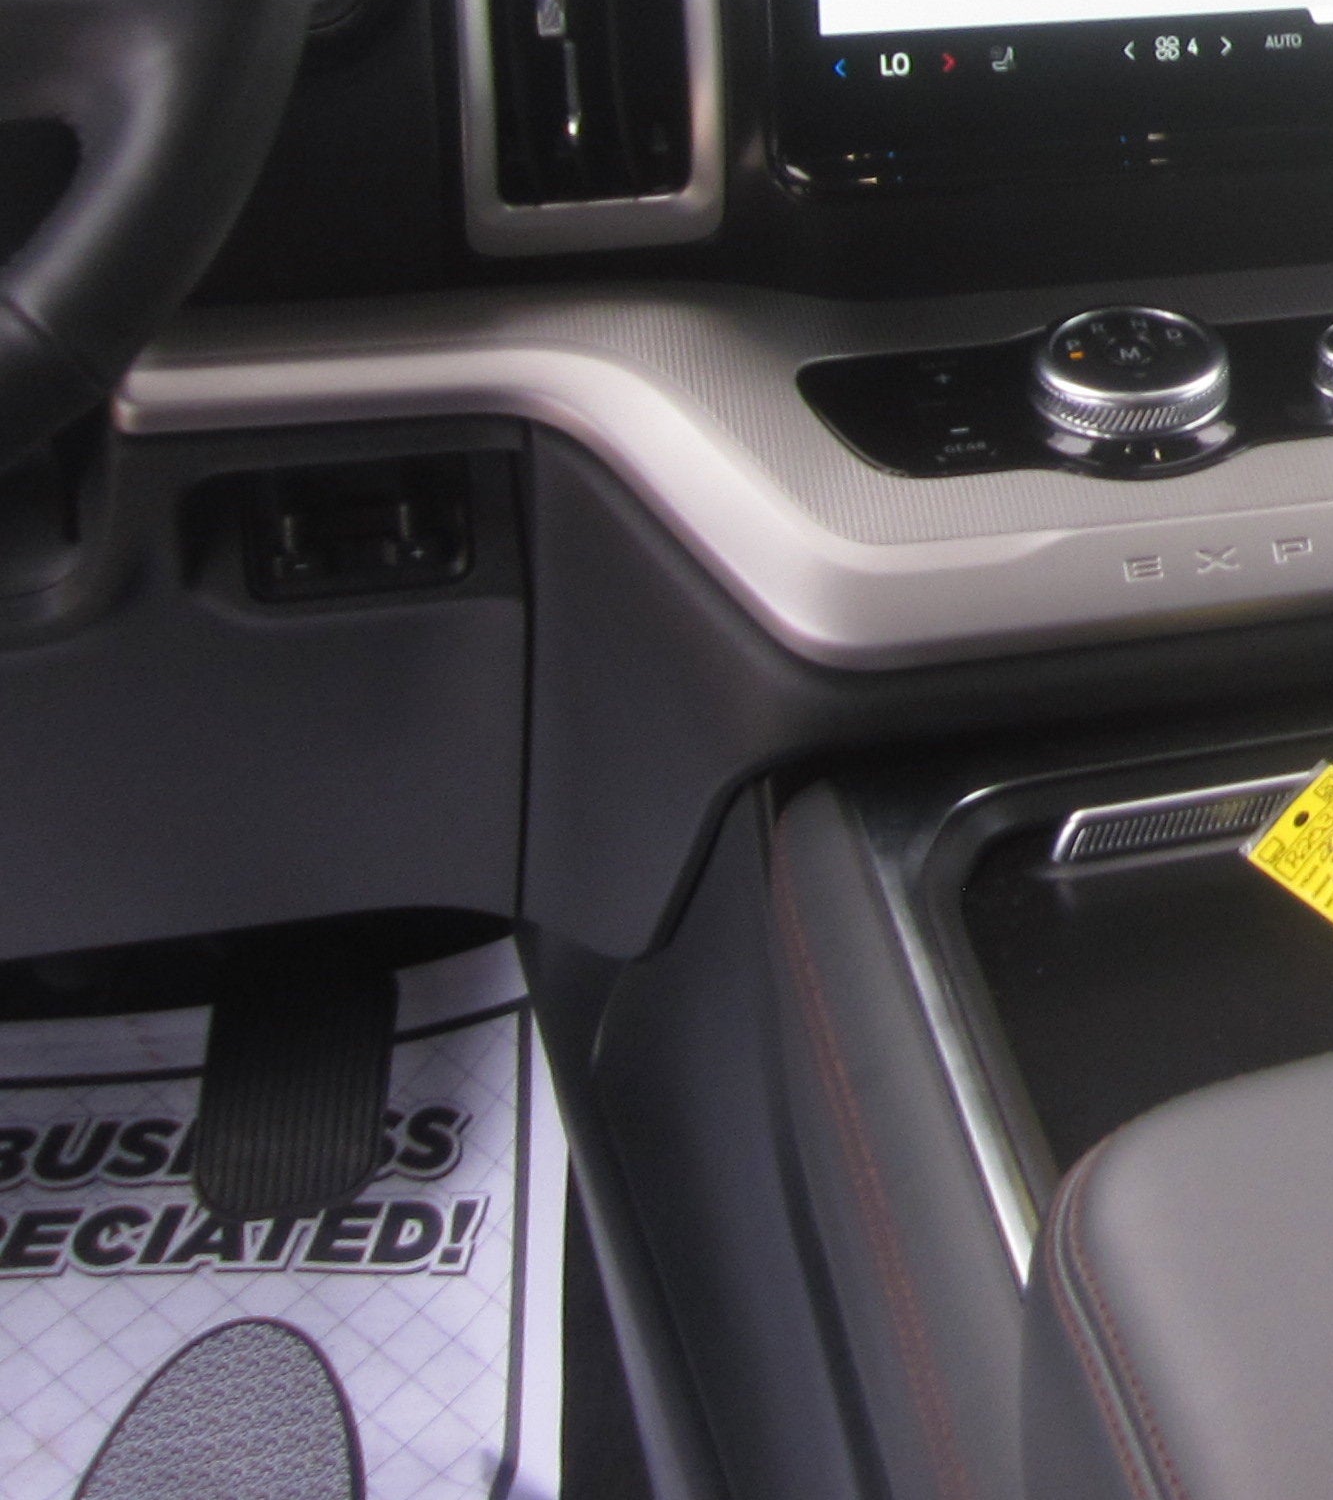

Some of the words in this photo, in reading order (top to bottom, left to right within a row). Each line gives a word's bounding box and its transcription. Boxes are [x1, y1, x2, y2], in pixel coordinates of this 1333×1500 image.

[1187, 38, 1199, 56] 4
[1264, 34, 1302, 49] AUTO
[879, 52, 910, 77] LO
[1119, 347, 1141, 360] M
[0, 1105, 468, 1190] BUSIS
[0, 1196, 489, 1275] ECIATED!
